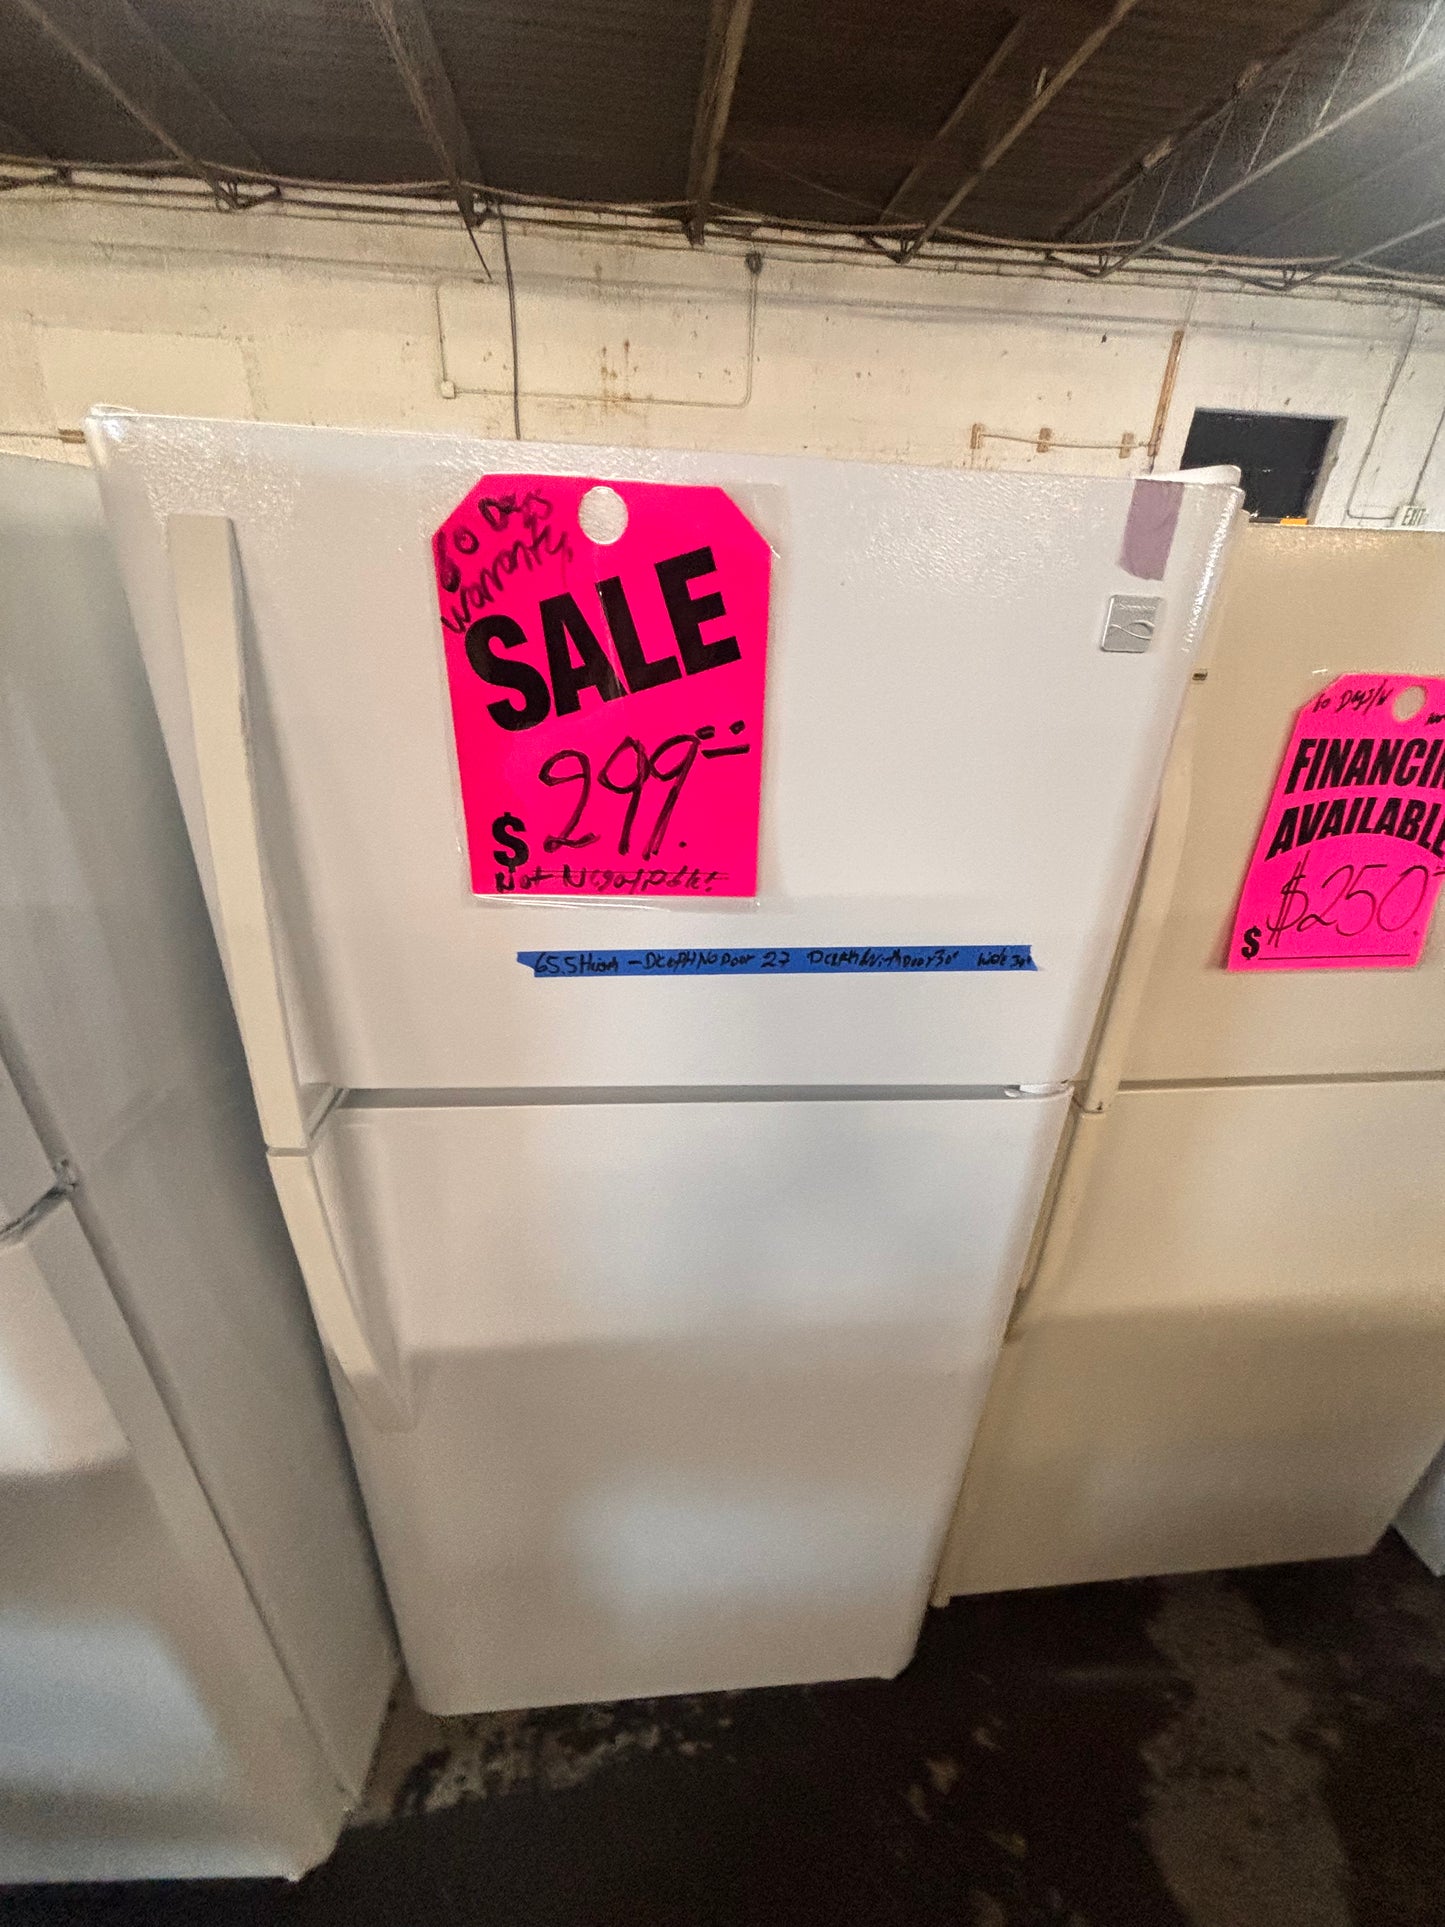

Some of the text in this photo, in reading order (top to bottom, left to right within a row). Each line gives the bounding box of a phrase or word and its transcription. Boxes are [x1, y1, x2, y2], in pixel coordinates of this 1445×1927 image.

[1401, 507, 1427, 526] EXIT
[464, 545, 742, 732] SALE
[491, 811, 530, 873] $
[1240, 925, 1263, 960] $
